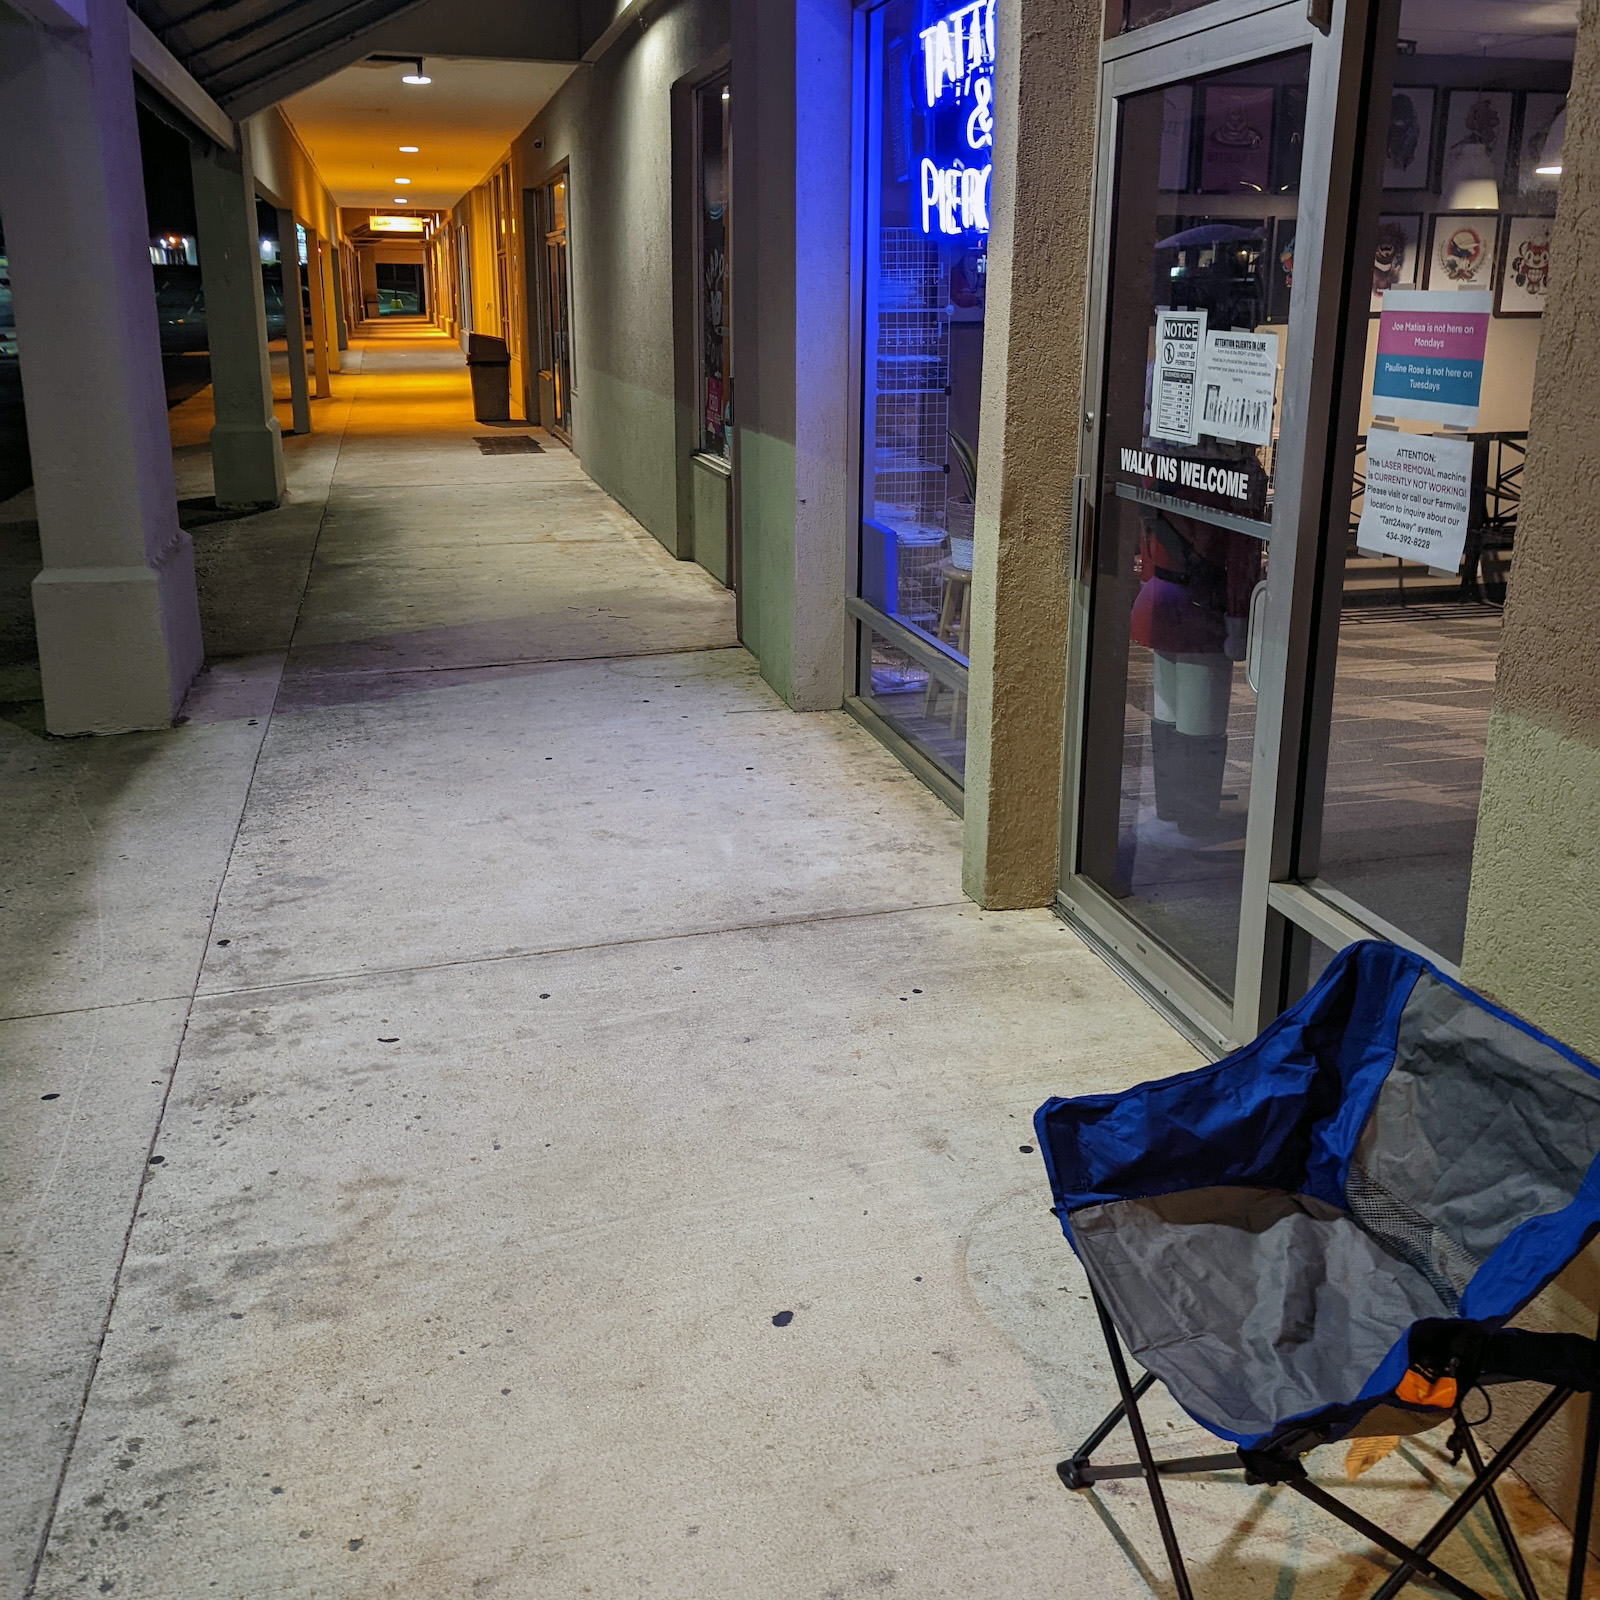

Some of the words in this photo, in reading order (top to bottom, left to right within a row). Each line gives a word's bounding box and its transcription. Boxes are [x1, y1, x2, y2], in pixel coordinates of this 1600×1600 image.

[1163, 322, 1198, 338] NOTICE
[1392, 321, 1404, 331] Joe
[1426, 323, 1433, 333] is
[1434, 324, 1446, 333] not
[1446, 324, 1463, 334] here
[1464, 326, 1474, 334] on
[1414, 337, 1445, 349] Mondays
[1384, 362, 1408, 373] Pauline
[1408, 364, 1425, 374] Rose
[1425, 366, 1432, 375] is
[1432, 367, 1444, 376] not
[1445, 367, 1461, 378] here
[1462, 371, 1473, 379] on
[1410, 379, 1441, 392] Tuesdays
[1396, 448, 1437, 463] ATTENTION:
[1120, 447, 1155, 478] WALK
[1155, 455, 1178, 483] INS
[1180, 460, 1250, 500] WELCOME
[1369, 457, 1381, 467] The
[1381, 459, 1402, 471] LASER
[1402, 463, 1436, 478] REMOVAL
[1436, 470, 1467, 483] machine
[1368, 470, 1374, 479] is
[1374, 472, 1412, 486] CURRENTLY
[1412, 480, 1428, 490] NOT
[1366, 485, 1387, 496] Please
[1387, 488, 1401, 499] visit
[1409, 494, 1421, 503] call
[1422, 497, 1434, 506] our
[1435, 498, 1467, 513] Farmville
[1370, 498, 1395, 512] location
[1403, 507, 1426, 519] inquire
[1426, 512, 1447, 524] about
[1447, 518, 1460, 526] our
